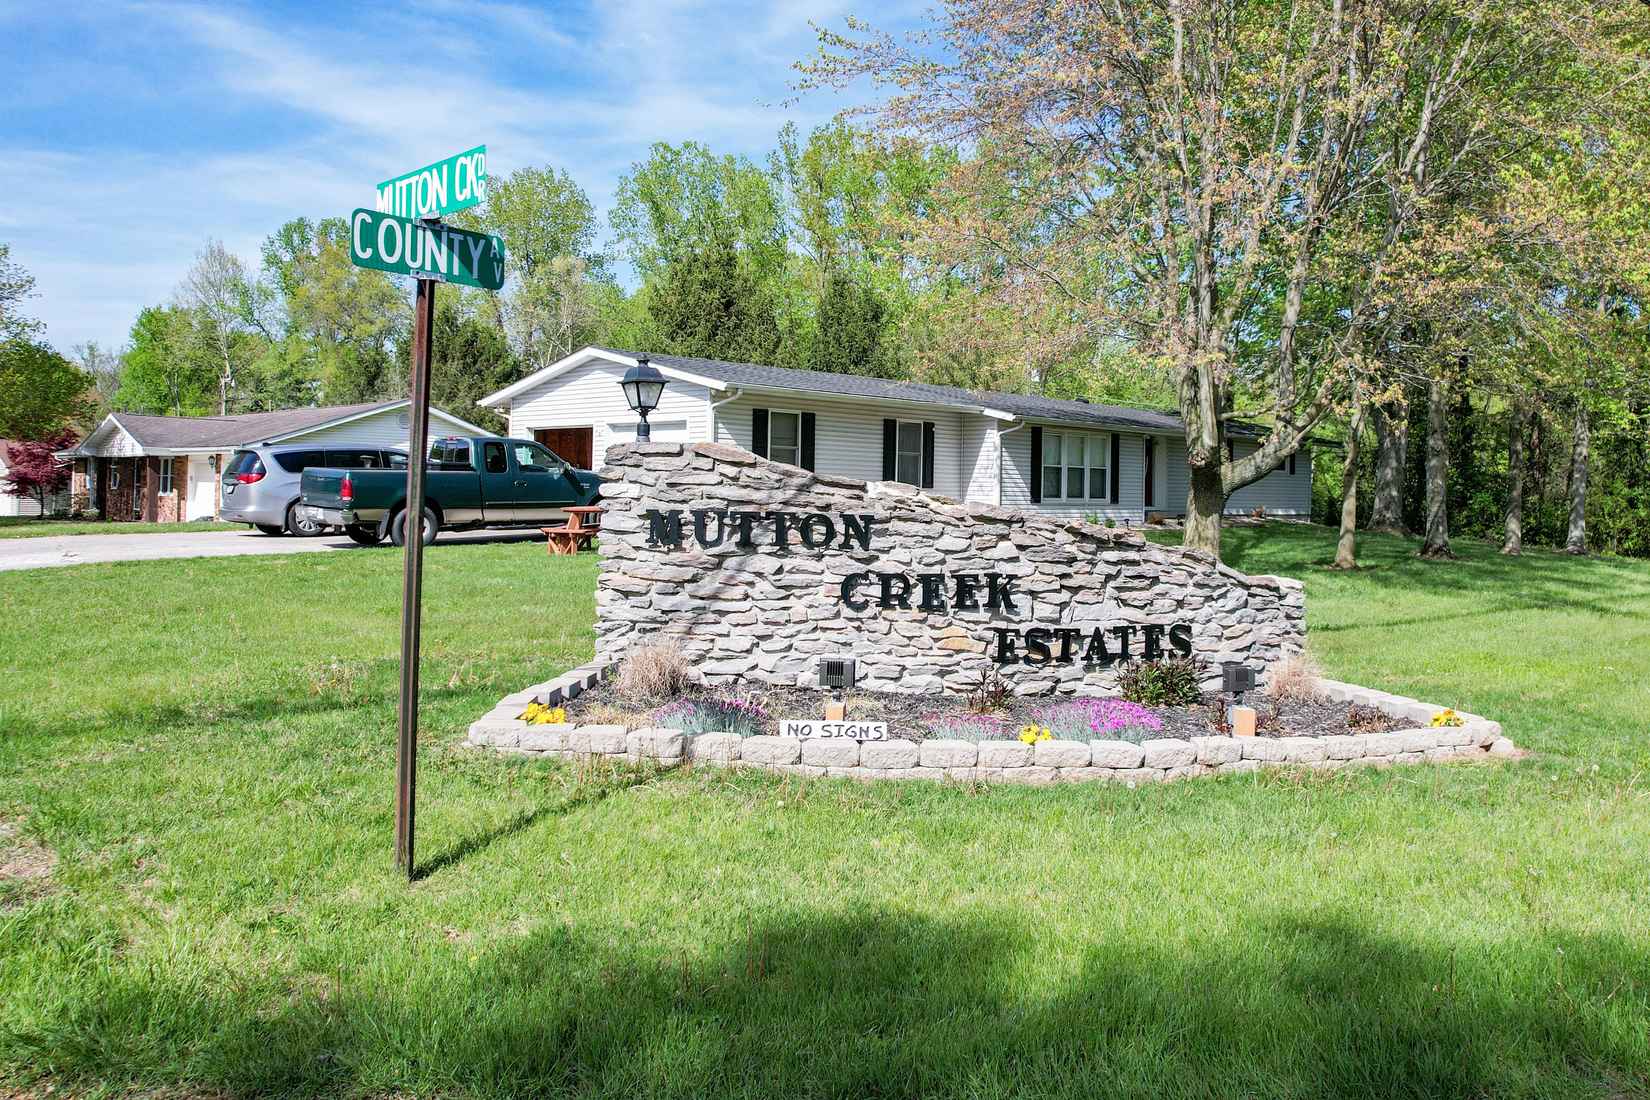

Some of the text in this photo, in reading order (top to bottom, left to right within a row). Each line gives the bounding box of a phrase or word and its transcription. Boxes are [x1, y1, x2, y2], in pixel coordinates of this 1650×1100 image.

[376, 164, 448, 220] MUTTON
[454, 155, 480, 201] CK
[353, 212, 486, 280] COUNTY
[645, 509, 875, 550] MUTTON
[840, 572, 1019, 613] CREEK
[992, 624, 1193, 664] ESTATES
[787, 723, 884, 740] NO SIGNS
